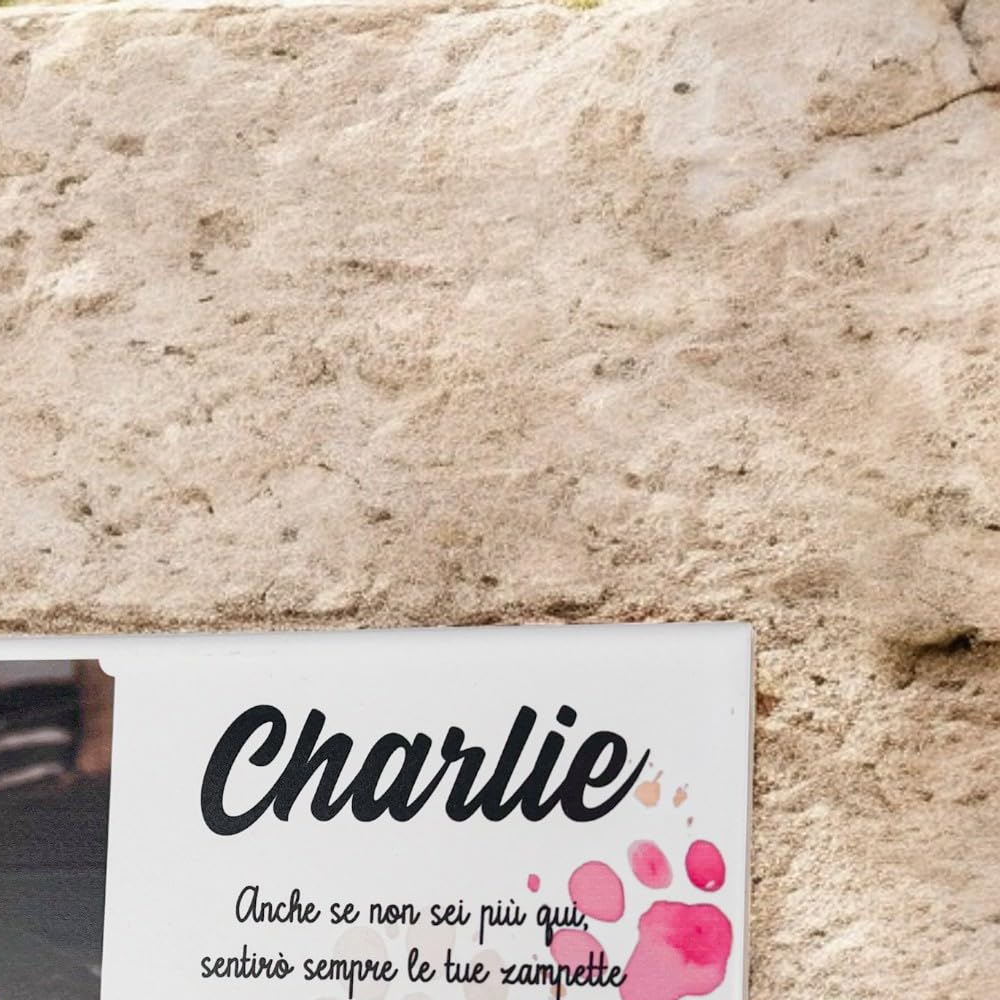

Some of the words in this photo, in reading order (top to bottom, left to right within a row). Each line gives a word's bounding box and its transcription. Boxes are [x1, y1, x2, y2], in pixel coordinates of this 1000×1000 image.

[200, 704, 651, 836] Charlie
[235, 885, 321, 924] Anche
[330, 902, 361, 925] se
[369, 903, 421, 925] non
[430, 899, 471, 926] sei
[479, 898, 527, 945] più
[536, 899, 590, 947] qui,
[201, 944, 295, 980] sentirò
[303, 958, 399, 1000] sempre
[407, 947, 437, 983] le
[443, 948, 491, 984] tue
